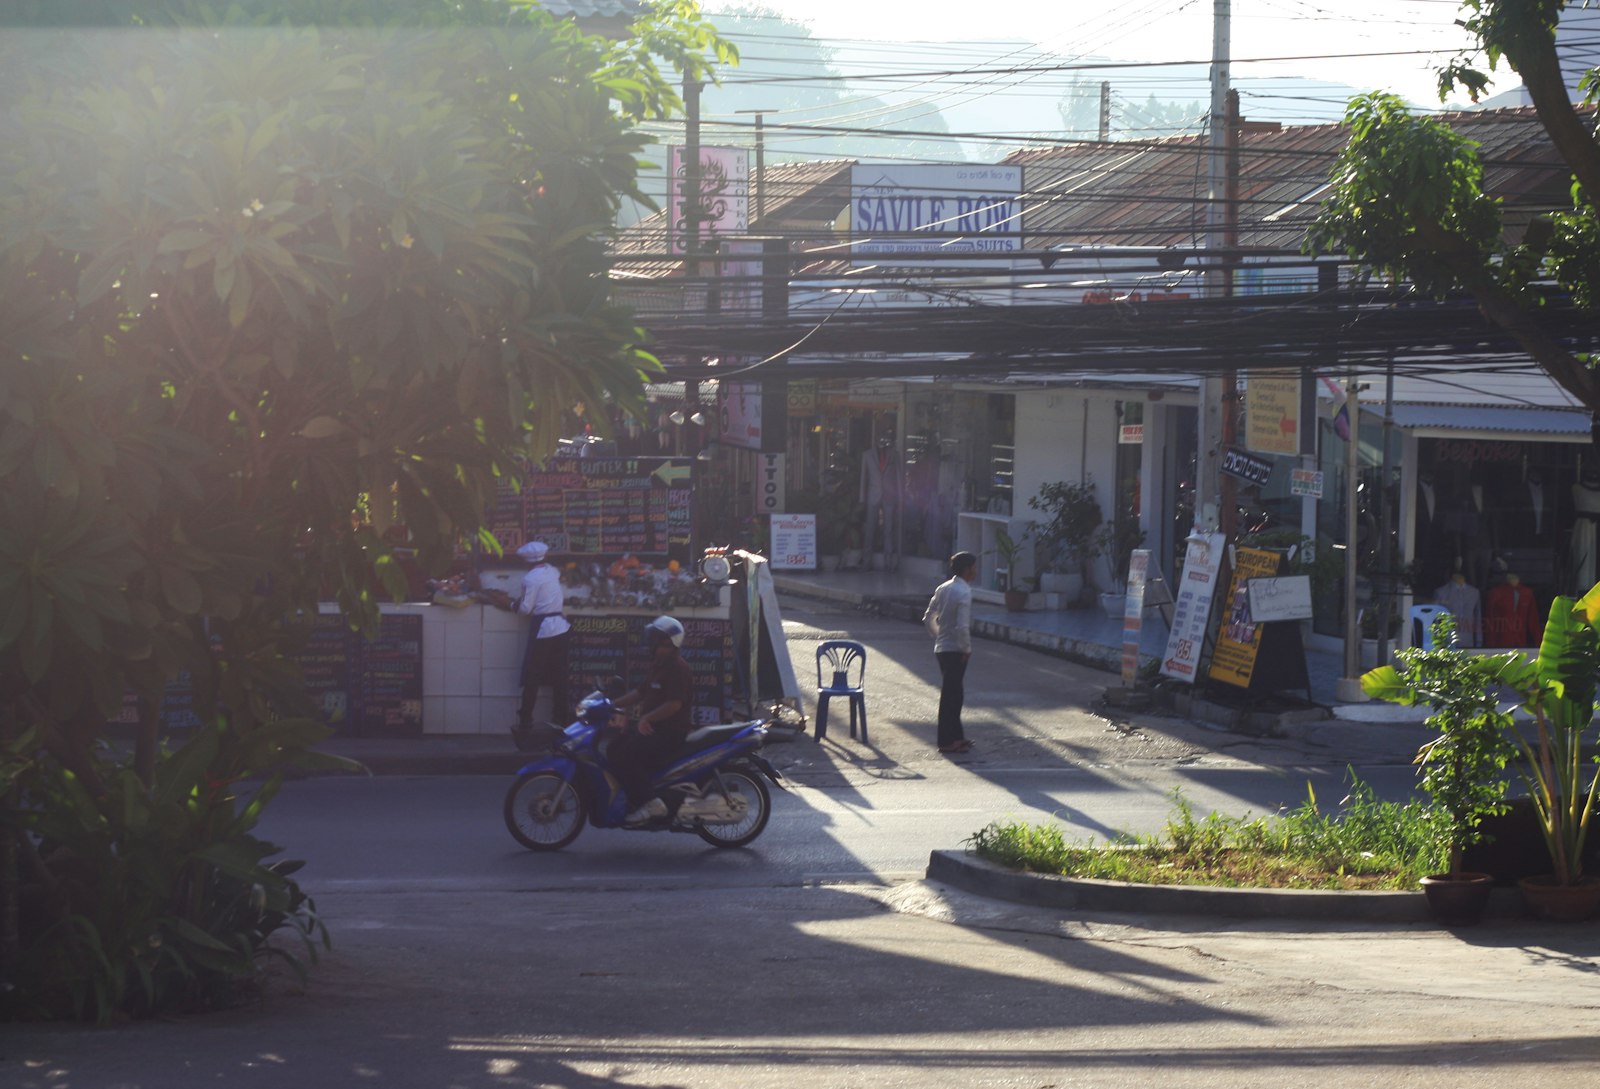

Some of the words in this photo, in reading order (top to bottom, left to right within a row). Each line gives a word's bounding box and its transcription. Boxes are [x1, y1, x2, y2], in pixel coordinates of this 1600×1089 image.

[857, 194, 945, 232] SAVILE
[958, 194, 1014, 232] ROW
[976, 240, 1013, 251] SUITS
[557, 461, 578, 473] WIE
[580, 461, 623, 474] BUTTER
[1237, 550, 1279, 570] EUROPEAN
[1175, 640, 1192, 660] 85
